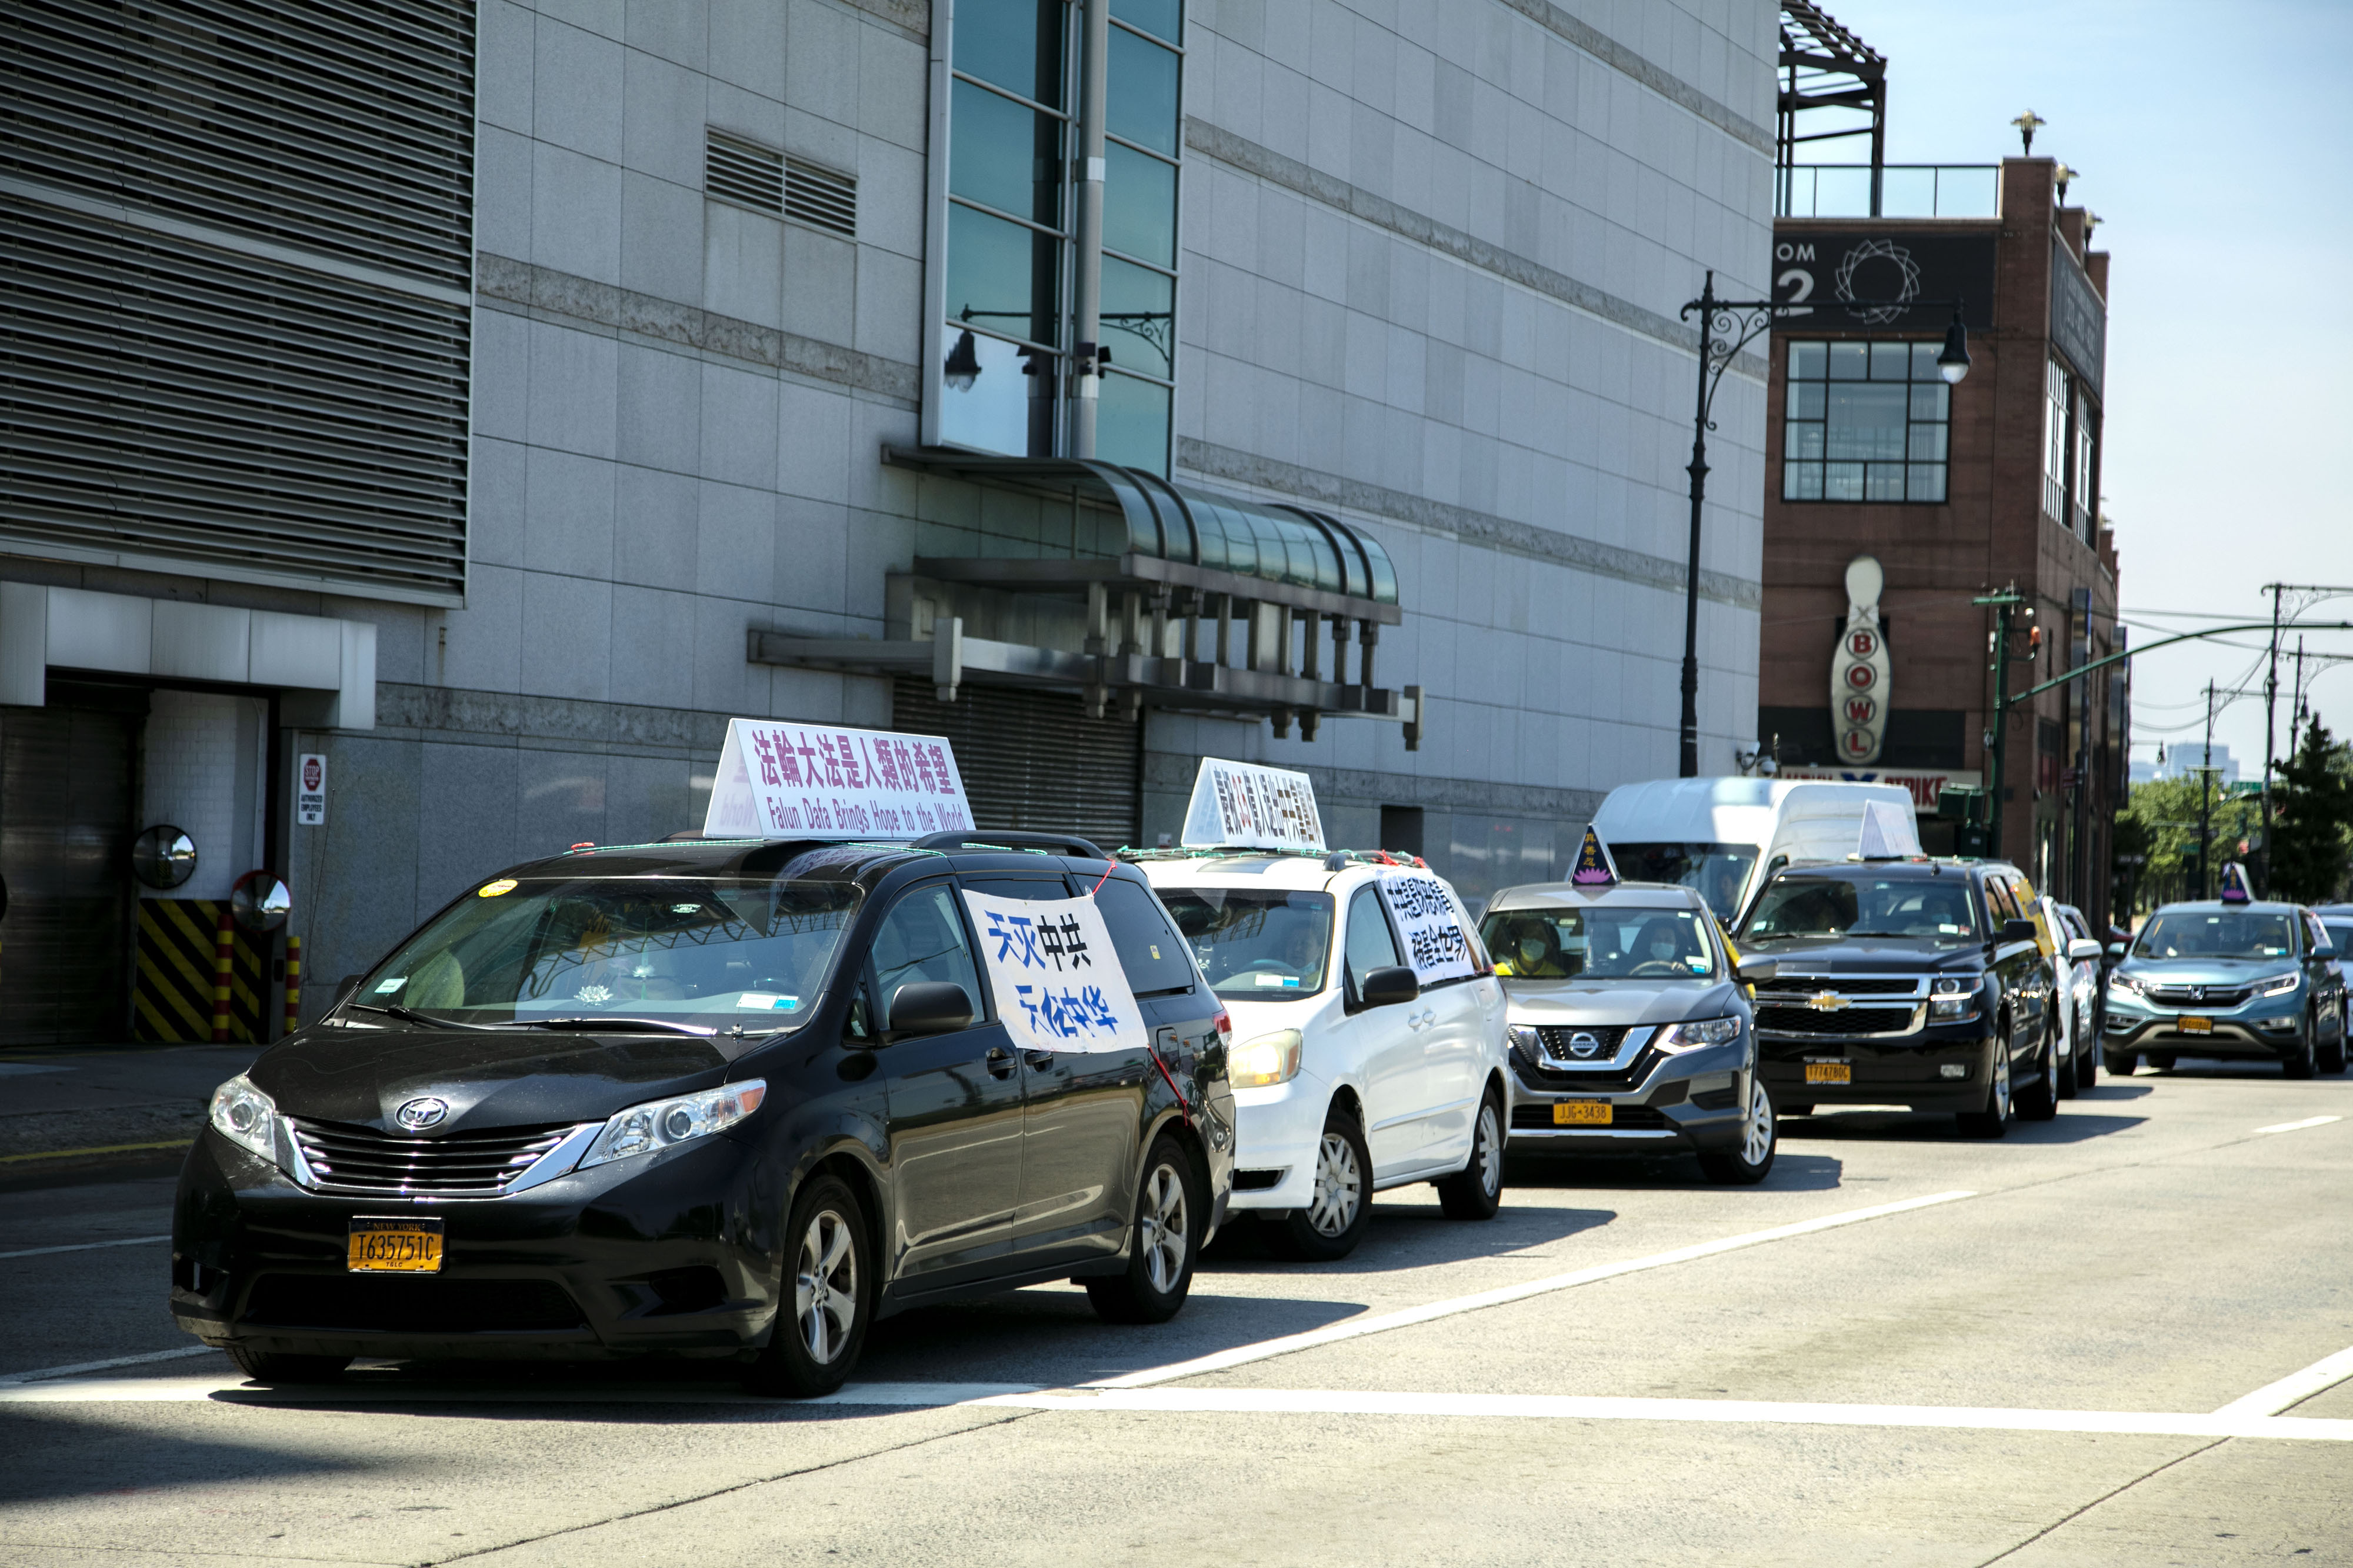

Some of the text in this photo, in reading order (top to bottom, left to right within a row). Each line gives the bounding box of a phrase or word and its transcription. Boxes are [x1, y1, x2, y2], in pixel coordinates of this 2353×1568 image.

[1849, 633, 1872, 752] BOWL
[305, 765, 319, 776] STOP
[752, 729, 955, 794] 法輪大法是人類的希望
[301, 803, 322, 812] EMPLOYEES
[306, 813, 316, 822] ONLY
[766, 796, 966, 838] Falun Dafa Brings Hope to the World
[1387, 876, 1454, 922] 中共是最邪恶病毒
[984, 909, 1091, 972] 天灭中共
[1015, 985, 1118, 1037] 天佑中华
[358, 1235, 434, 1260] T635751C
